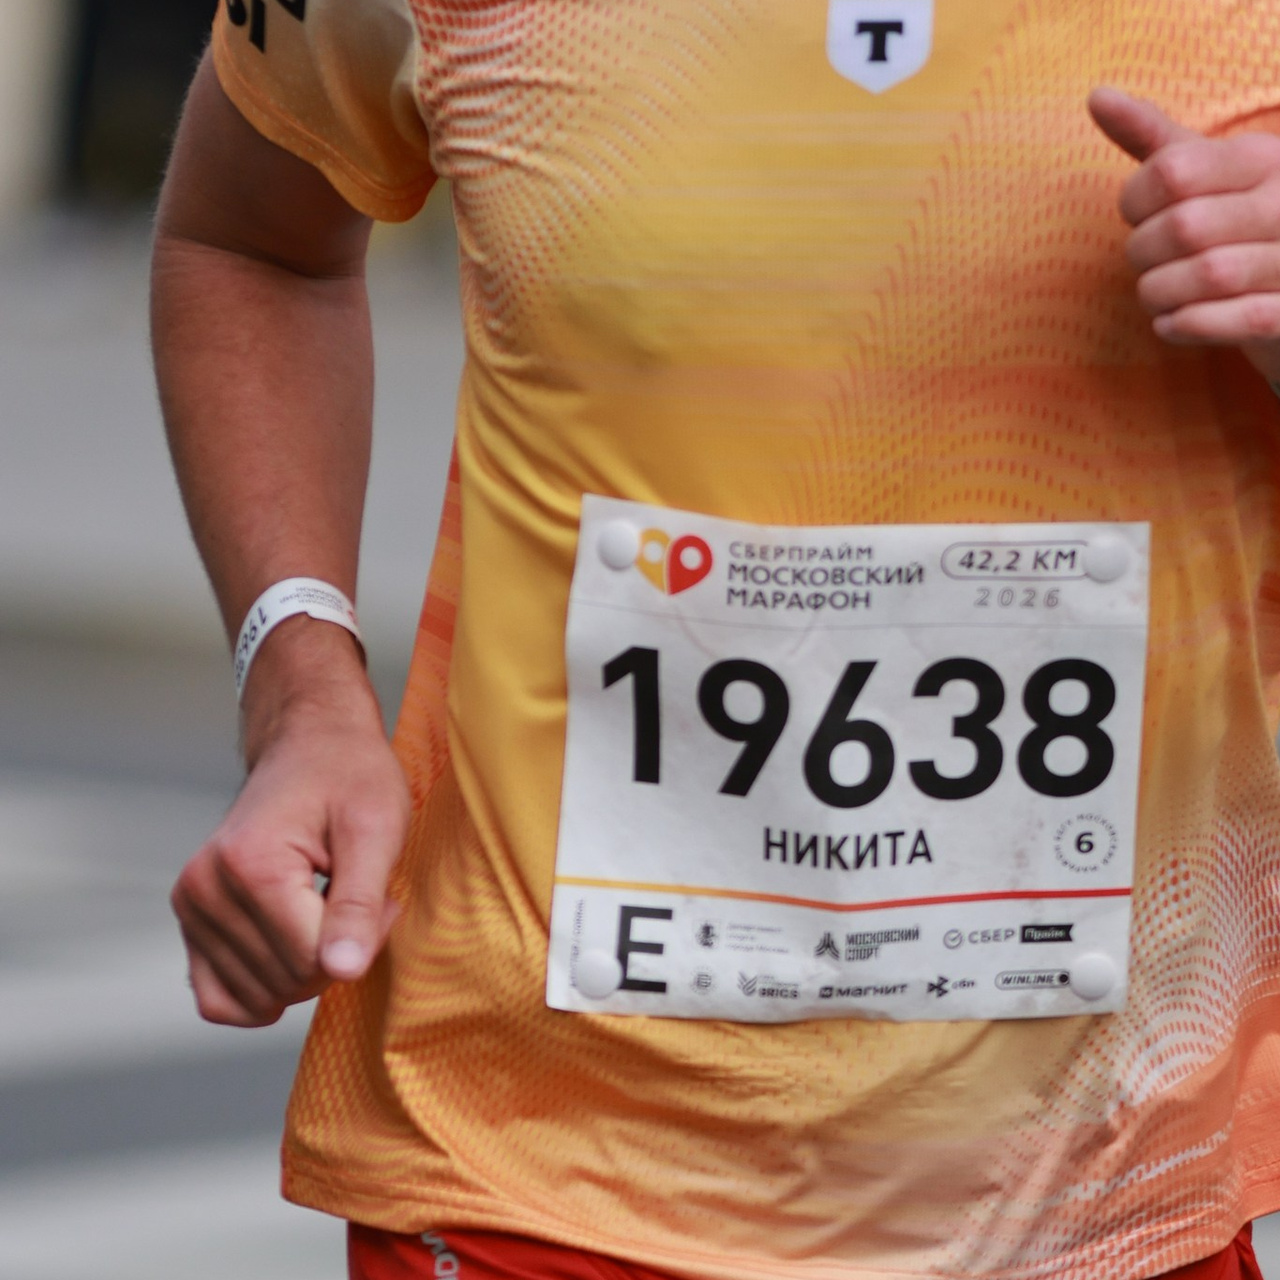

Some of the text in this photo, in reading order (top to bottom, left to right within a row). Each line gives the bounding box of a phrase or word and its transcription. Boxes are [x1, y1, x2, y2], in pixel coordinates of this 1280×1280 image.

[856, 20, 904, 62] Т
[728, 540, 874, 562] СБЕРПРАЙМ
[958, 549, 1077, 573] 42,2 КМ
[728, 561, 925, 587] МОСКОВСКИЙ
[727, 588, 871, 611] МАРАФОН
[974, 587, 1061, 608] 2026
[602, 646, 1117, 809] 19638
[762, 827, 933, 870] НИКИТА
[1075, 831, 1094, 854] 6
[845, 926, 920, 947] МОСКОВСКИЙ
[968, 928, 1016, 945] СБЕР
[617, 904, 673, 993] E
